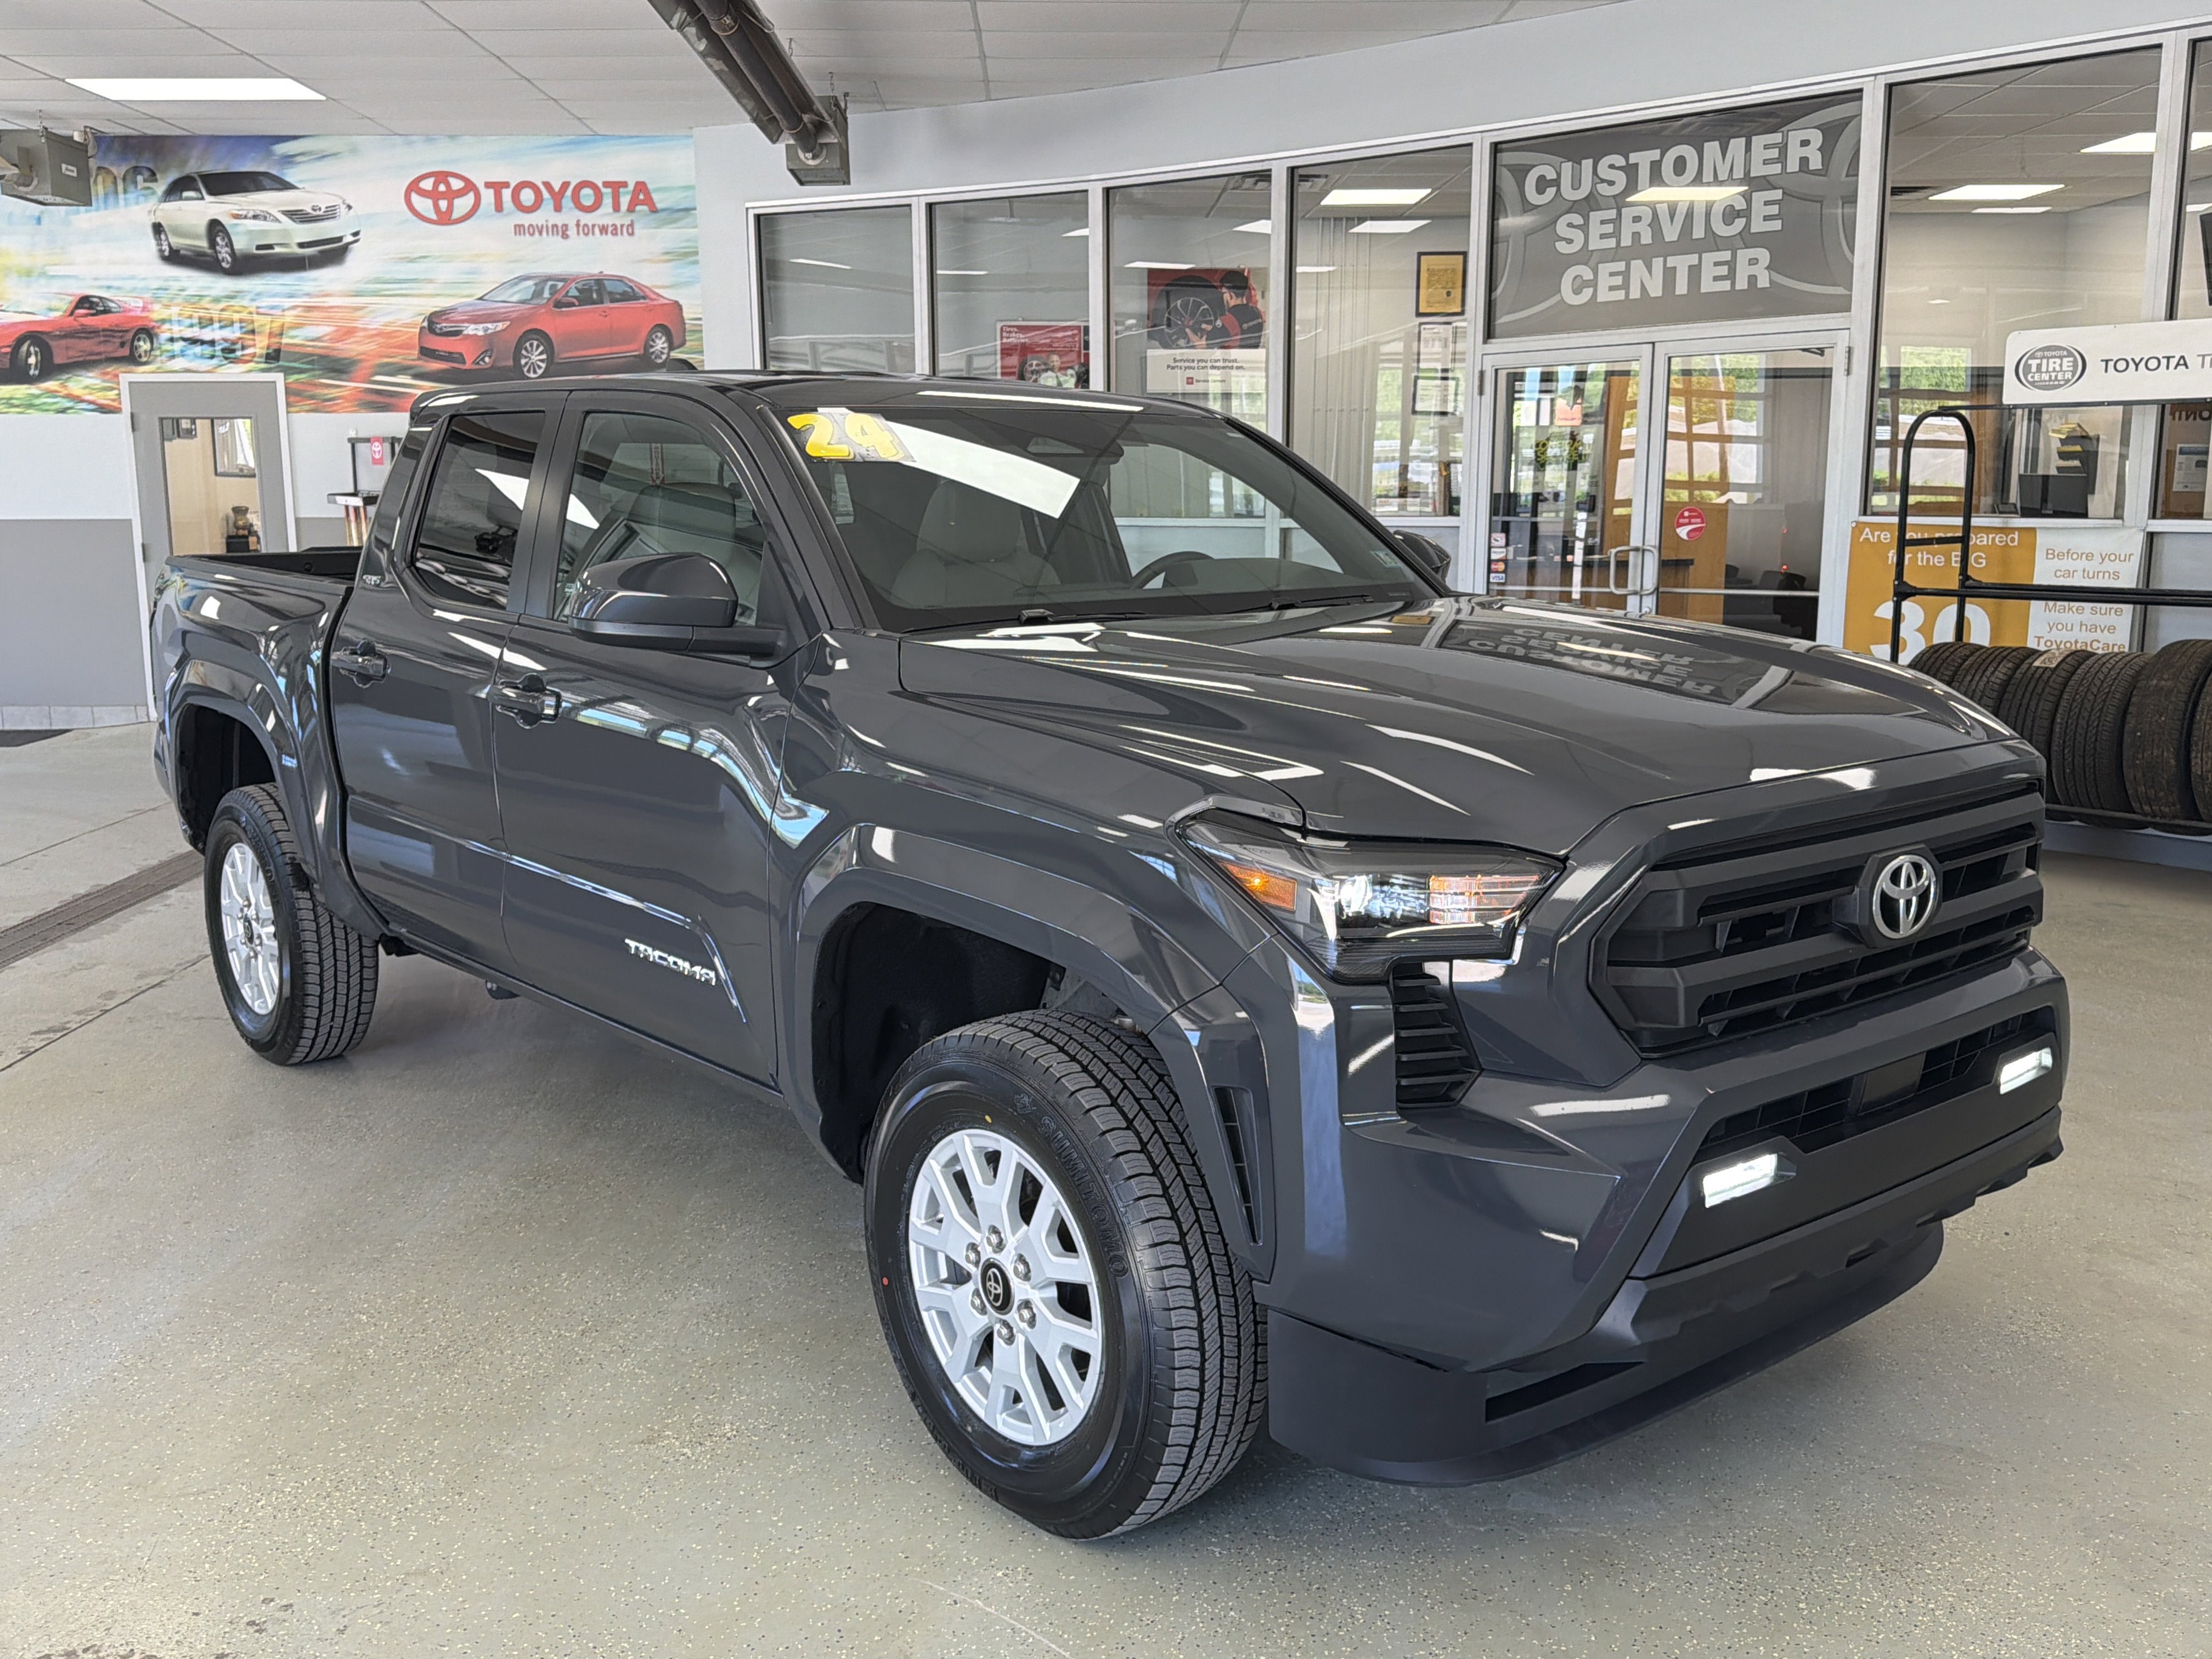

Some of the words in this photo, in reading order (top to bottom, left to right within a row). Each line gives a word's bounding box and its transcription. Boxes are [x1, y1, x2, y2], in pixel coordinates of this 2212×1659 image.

[1523, 127, 1824, 206] CUSTOMER
[484, 180, 657, 213] TOYOTA
[514, 219, 569, 239] moving
[575, 219, 635, 236] forward
[1554, 189, 1783, 255] SERVICE
[1560, 247, 1771, 306] CENTER
[2028, 357, 2074, 373] TIRE
[2101, 356, 2190, 374] TOYOTA
[2028, 372, 2072, 382] CENTER
[787, 413, 905, 460] 24
[1859, 527, 1891, 543] Are
[1934, 531, 2019, 546] ared
[1917, 551, 1945, 566] the
[1951, 551, 1987, 567] BG
[2045, 548, 2095, 561] Before
[2099, 552, 2134, 565] your
[2054, 568, 2078, 579] car
[2082, 568, 2120, 580] turns
[2044, 601, 2085, 615] Make
[2090, 606, 2124, 616] sure
[2047, 622, 2074, 634] you
[2079, 620, 2117, 634] have
[2034, 635, 2126, 653] ToyotaCare
[624, 938, 716, 987] TACOMA
[1040, 1115, 1128, 1278] SUMITOMO
